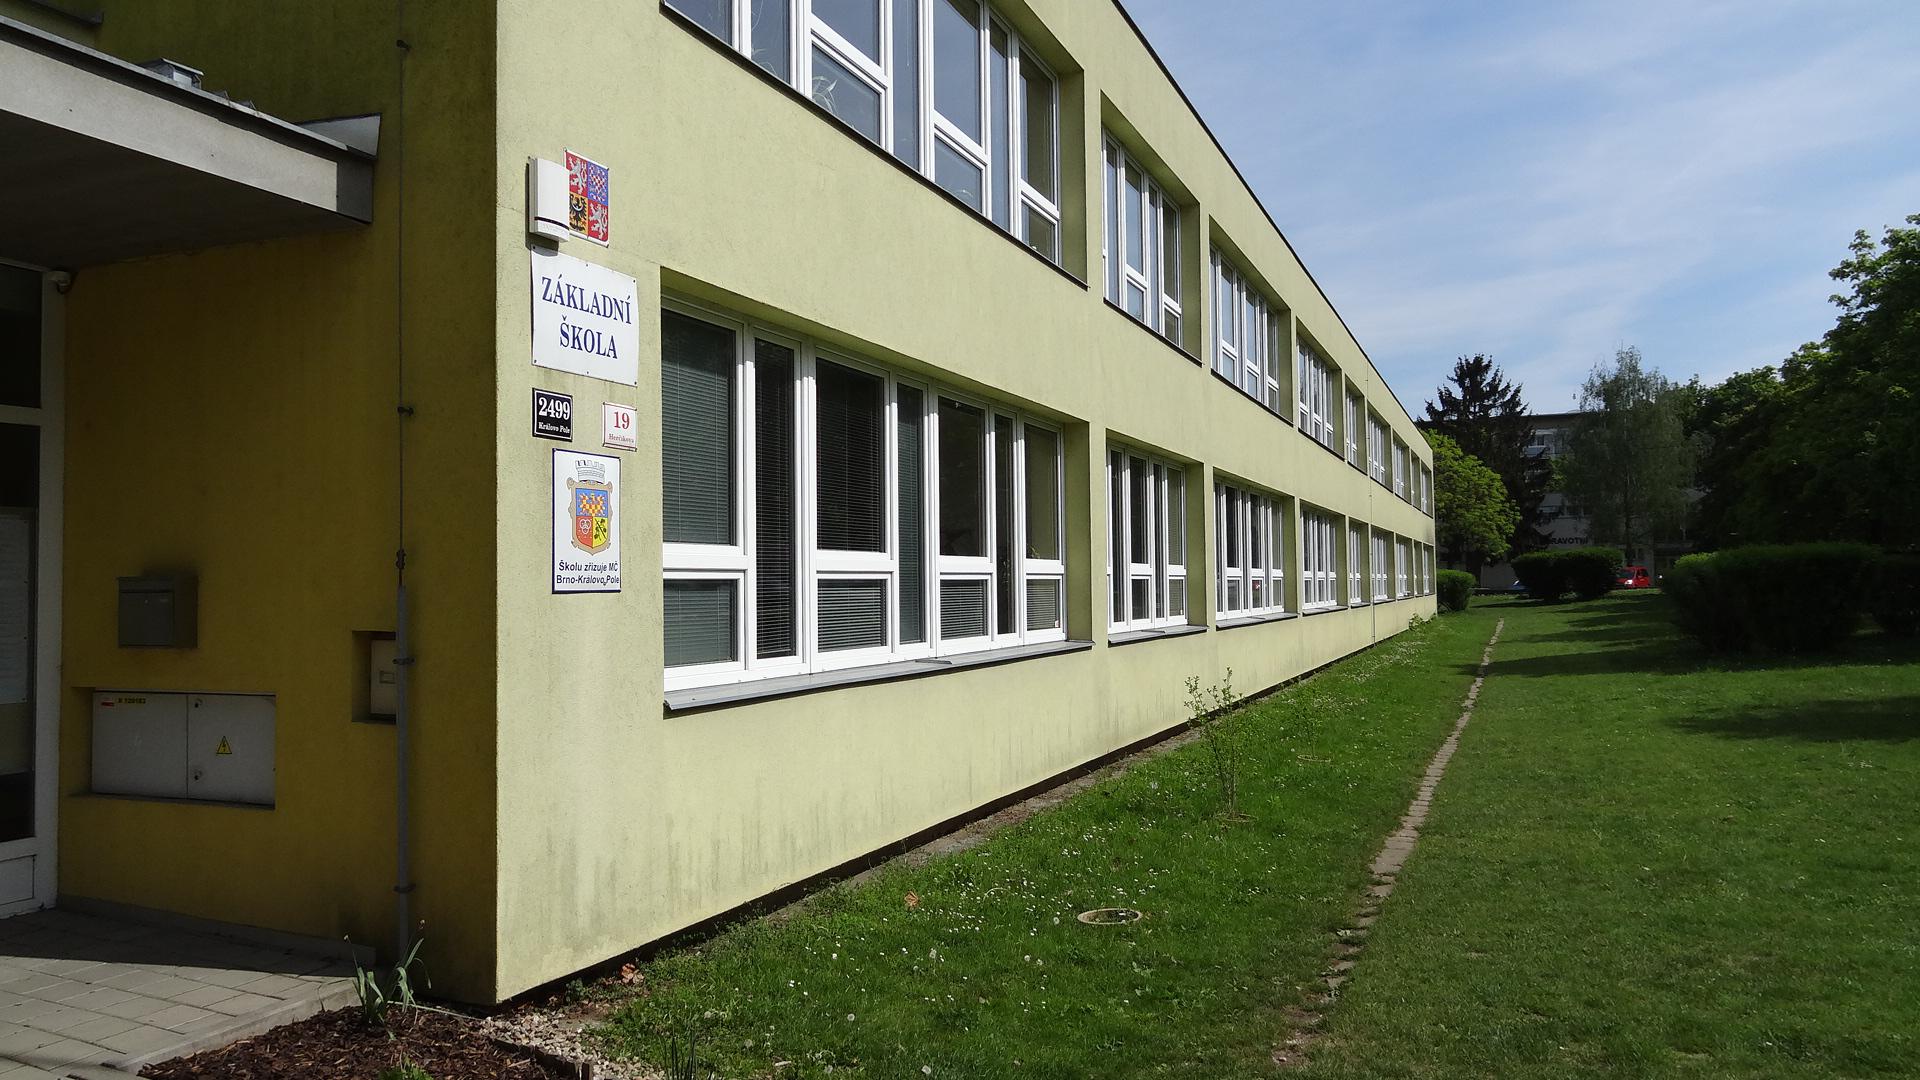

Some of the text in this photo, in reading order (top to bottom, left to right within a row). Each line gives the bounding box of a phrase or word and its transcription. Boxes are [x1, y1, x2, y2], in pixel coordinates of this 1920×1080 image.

[541, 274, 632, 325] ZÁKLADNÍ
[559, 315, 618, 360] ŠKOLA
[538, 397, 571, 420] 2499
[538, 421, 571, 434] Královo Pole
[613, 411, 630, 430] 19
[1551, 536, 1588, 544] RAVOTNÍ
[558, 560, 619, 574] Školu zřizuje MČ
[556, 574, 620, 584] Brno-Královo Pole
